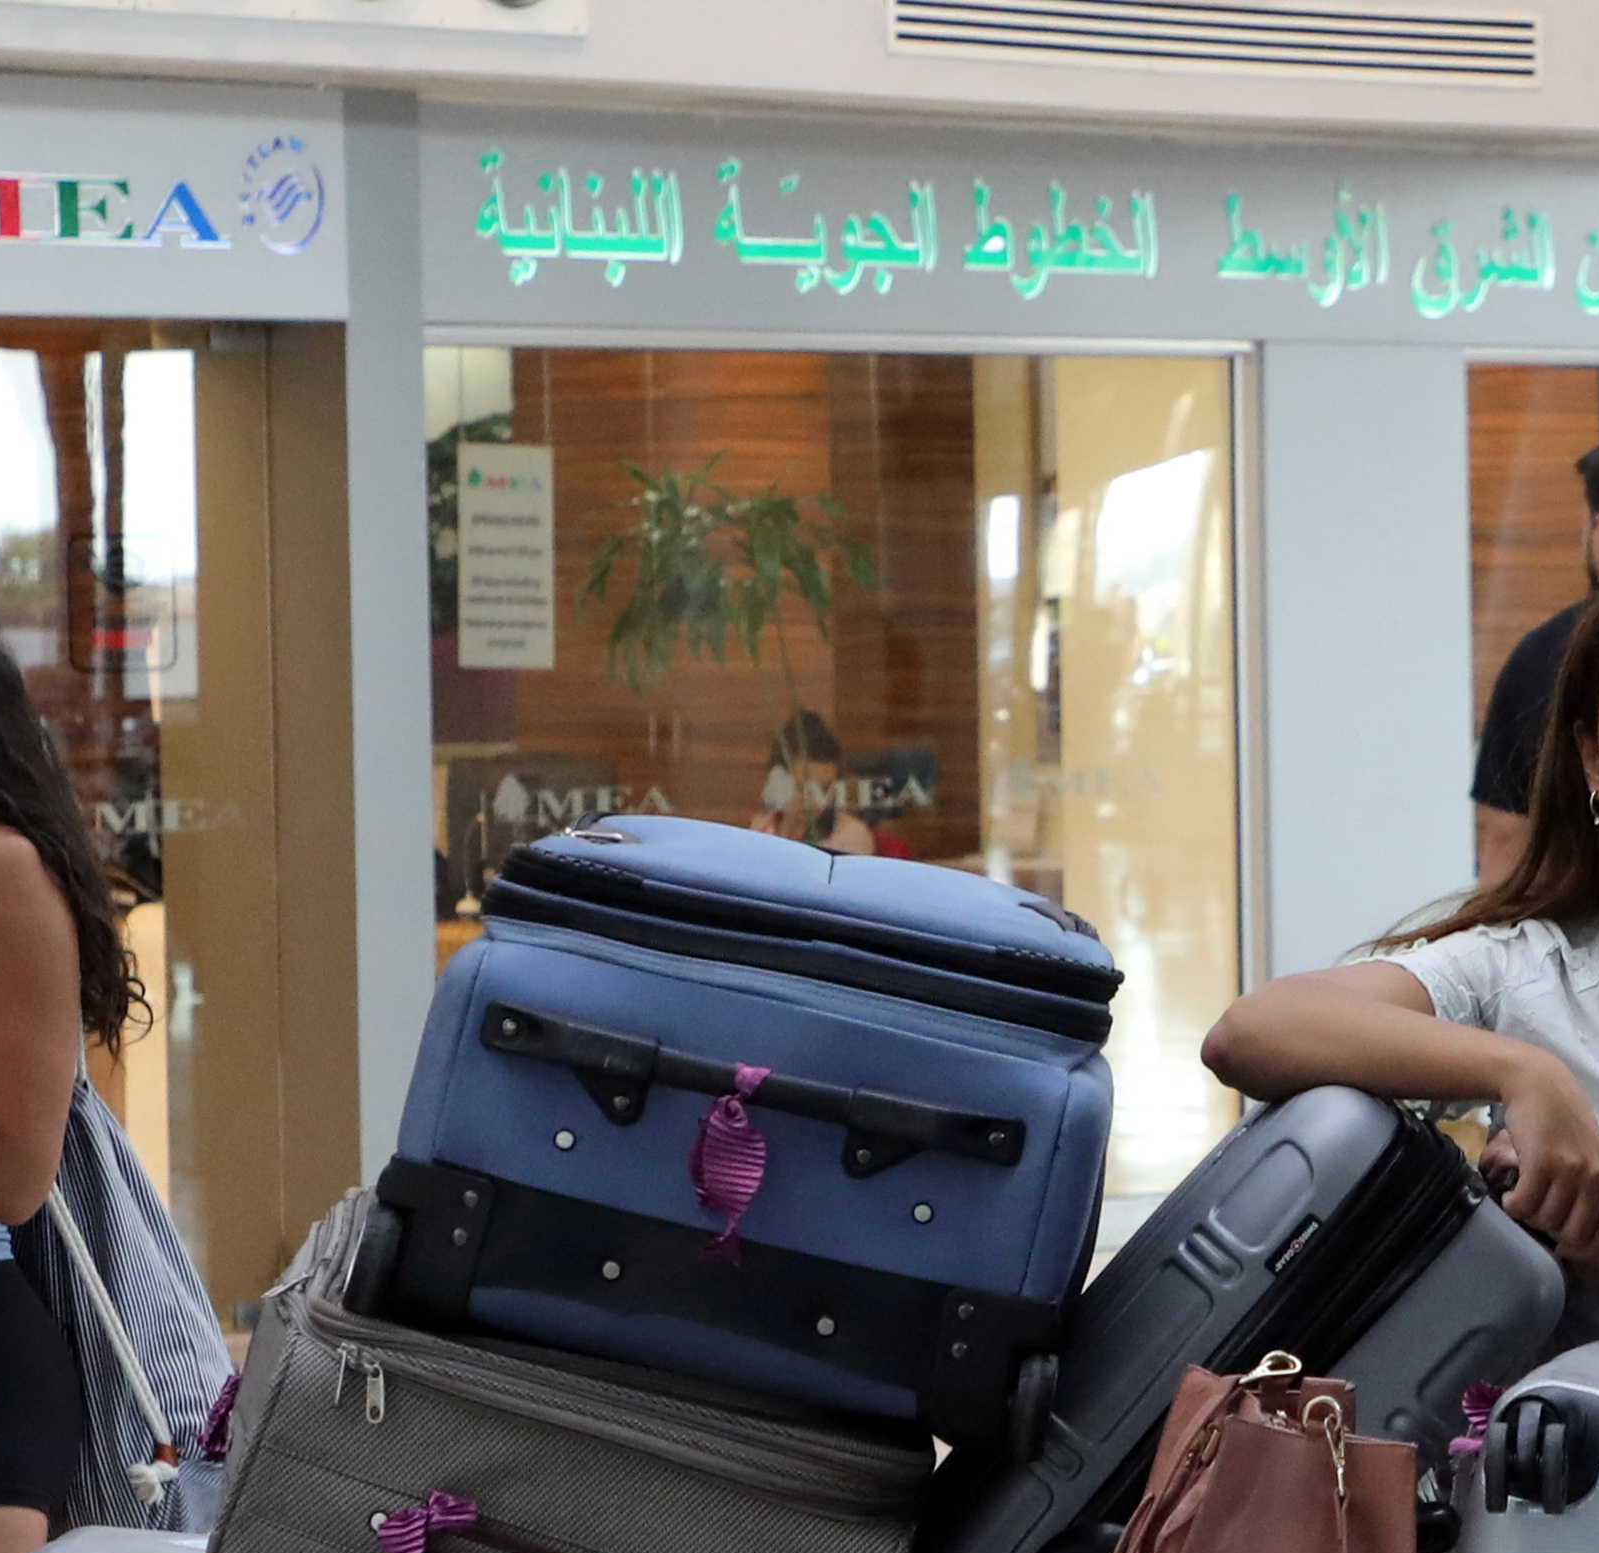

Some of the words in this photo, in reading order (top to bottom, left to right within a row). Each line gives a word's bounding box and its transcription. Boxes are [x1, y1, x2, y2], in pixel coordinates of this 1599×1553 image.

[475, 146, 683, 288] اللبنانية
[963, 176, 1157, 300] الخطوط
[1411, 204, 1556, 319] الشرق
[802, 773, 934, 809] MEA
